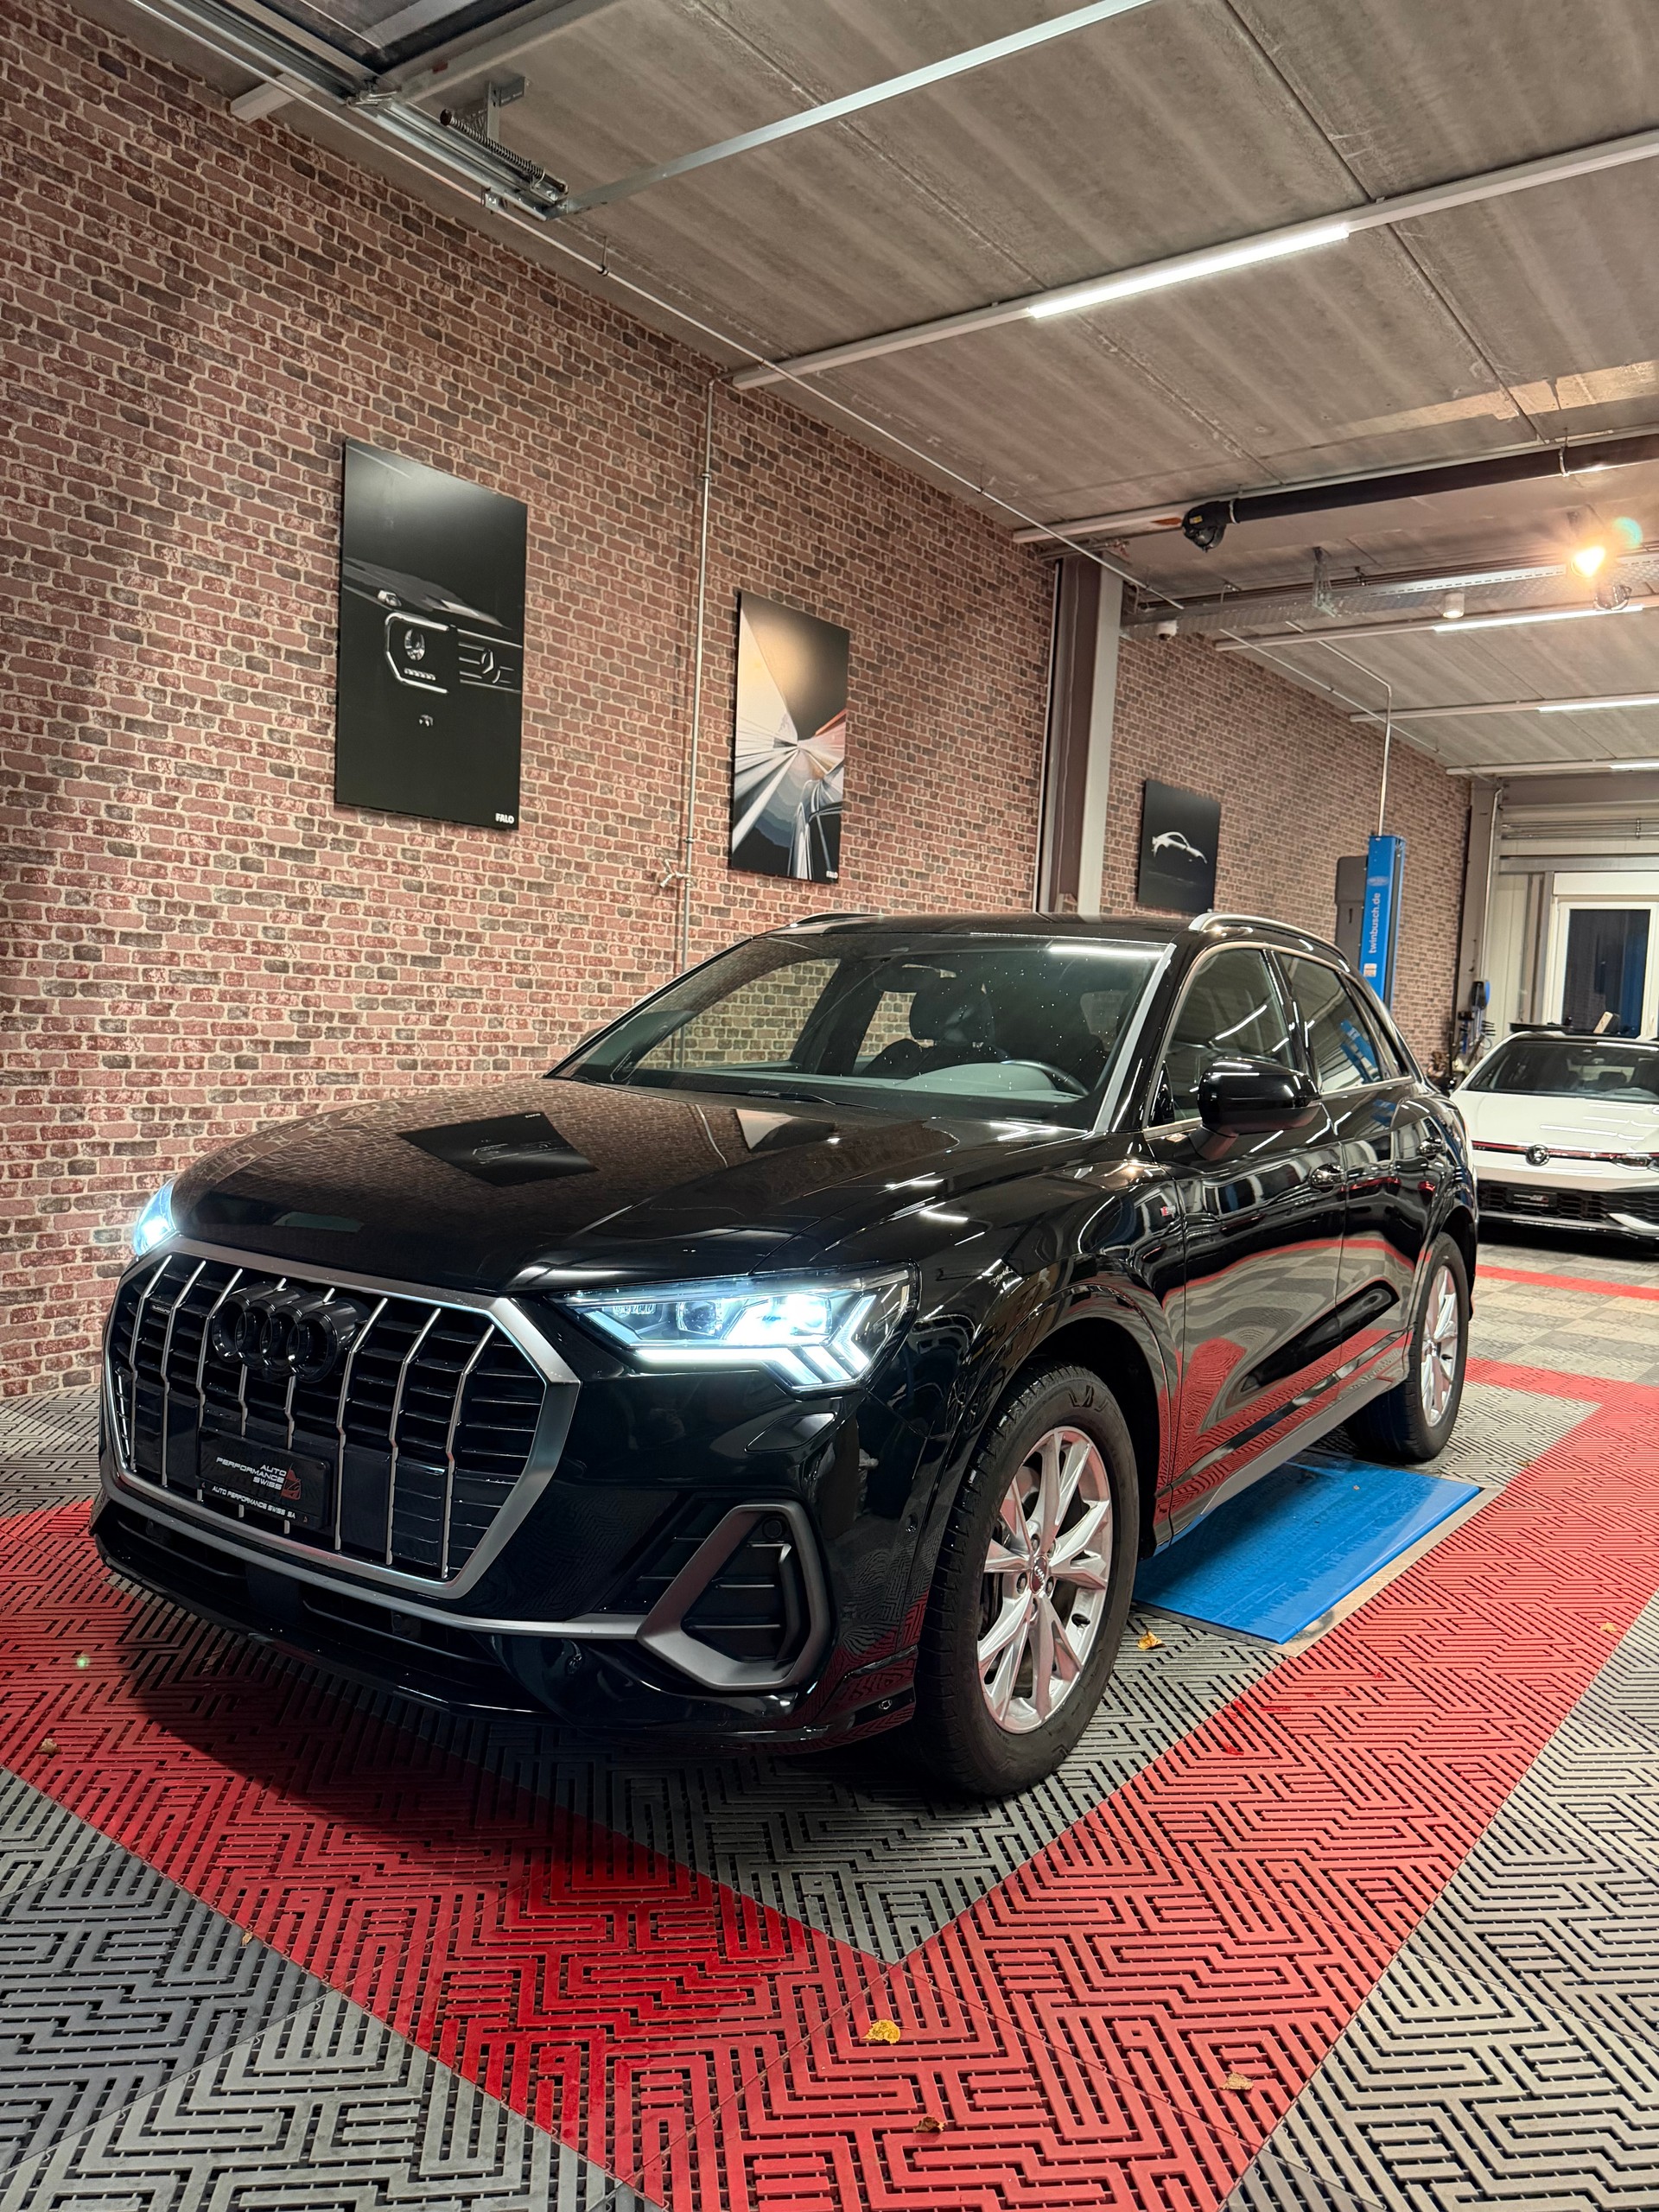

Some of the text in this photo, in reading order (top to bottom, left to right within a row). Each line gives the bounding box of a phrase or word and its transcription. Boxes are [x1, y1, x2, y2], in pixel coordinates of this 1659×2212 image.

[495, 813, 515, 824] FALO
[1369, 893, 1381, 954] twinbusch.de
[216, 1457, 285, 1484] PERFORMANCE
[260, 1465, 287, 1477] AUTO
[212, 1485, 296, 1519] AUTO PERFORMANCE SWISS SA
